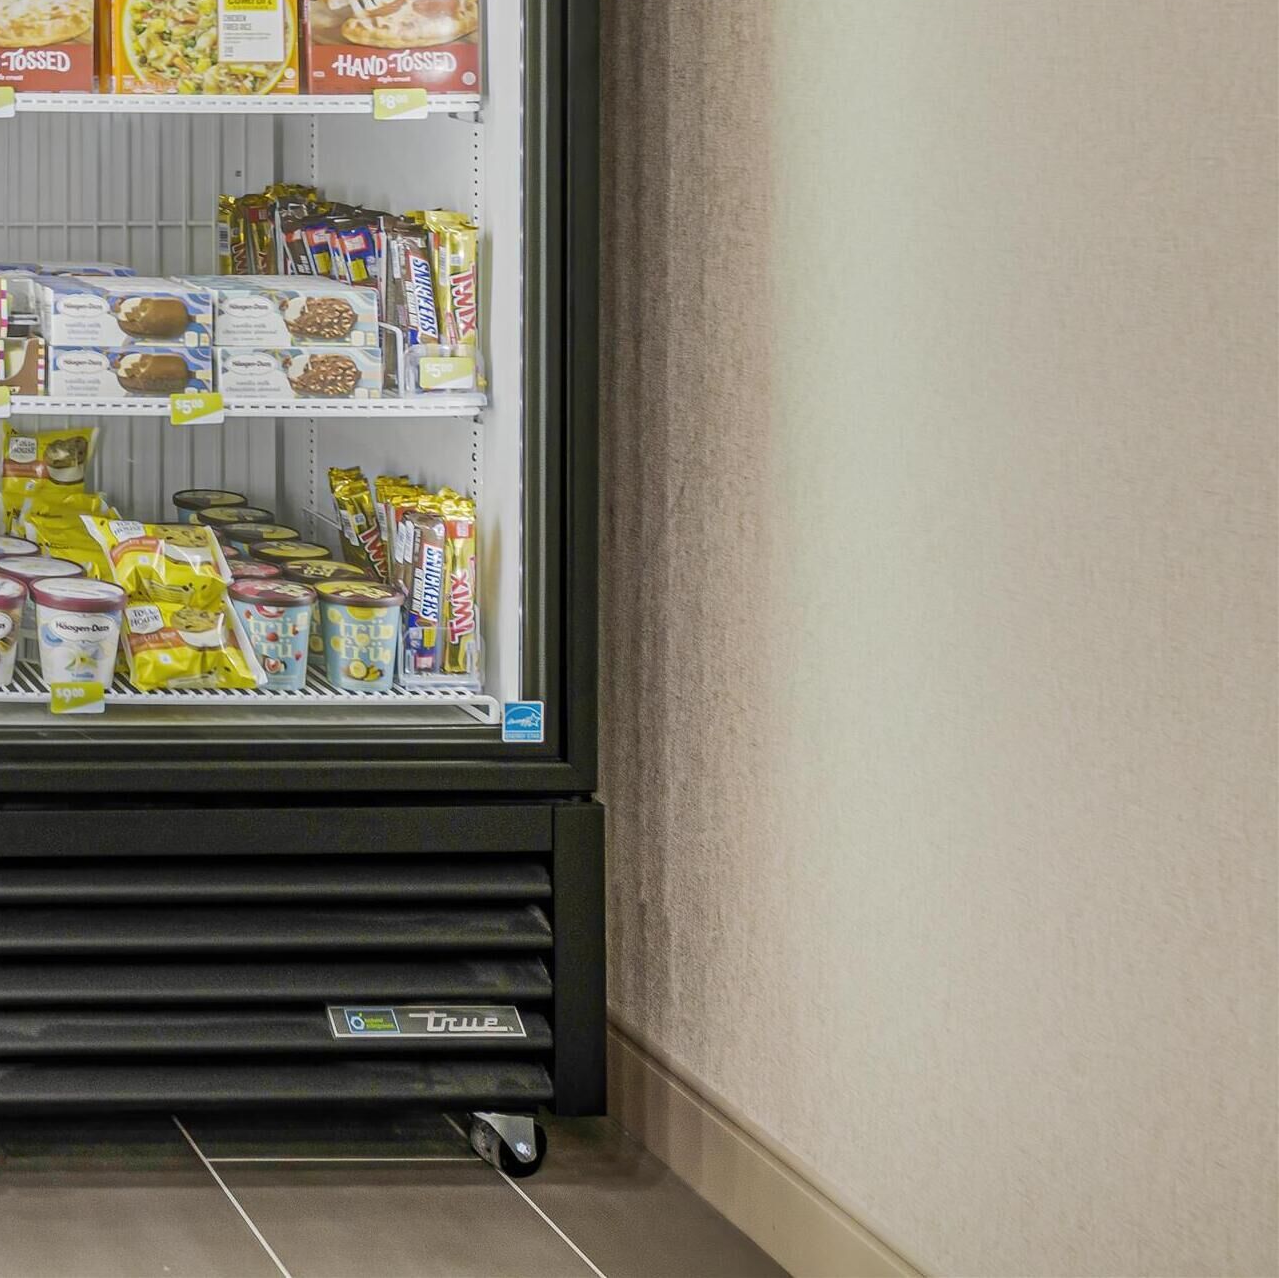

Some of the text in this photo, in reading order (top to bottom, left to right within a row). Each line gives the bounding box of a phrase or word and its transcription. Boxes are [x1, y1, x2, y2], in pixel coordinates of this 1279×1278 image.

[332, 50, 457, 80] HAND-TOSSED
[412, 257, 438, 337] SNICKERS
[450, 262, 476, 336] TWIX
[422, 546, 443, 621] SNICKERS
[450, 570, 476, 644] TWIX
